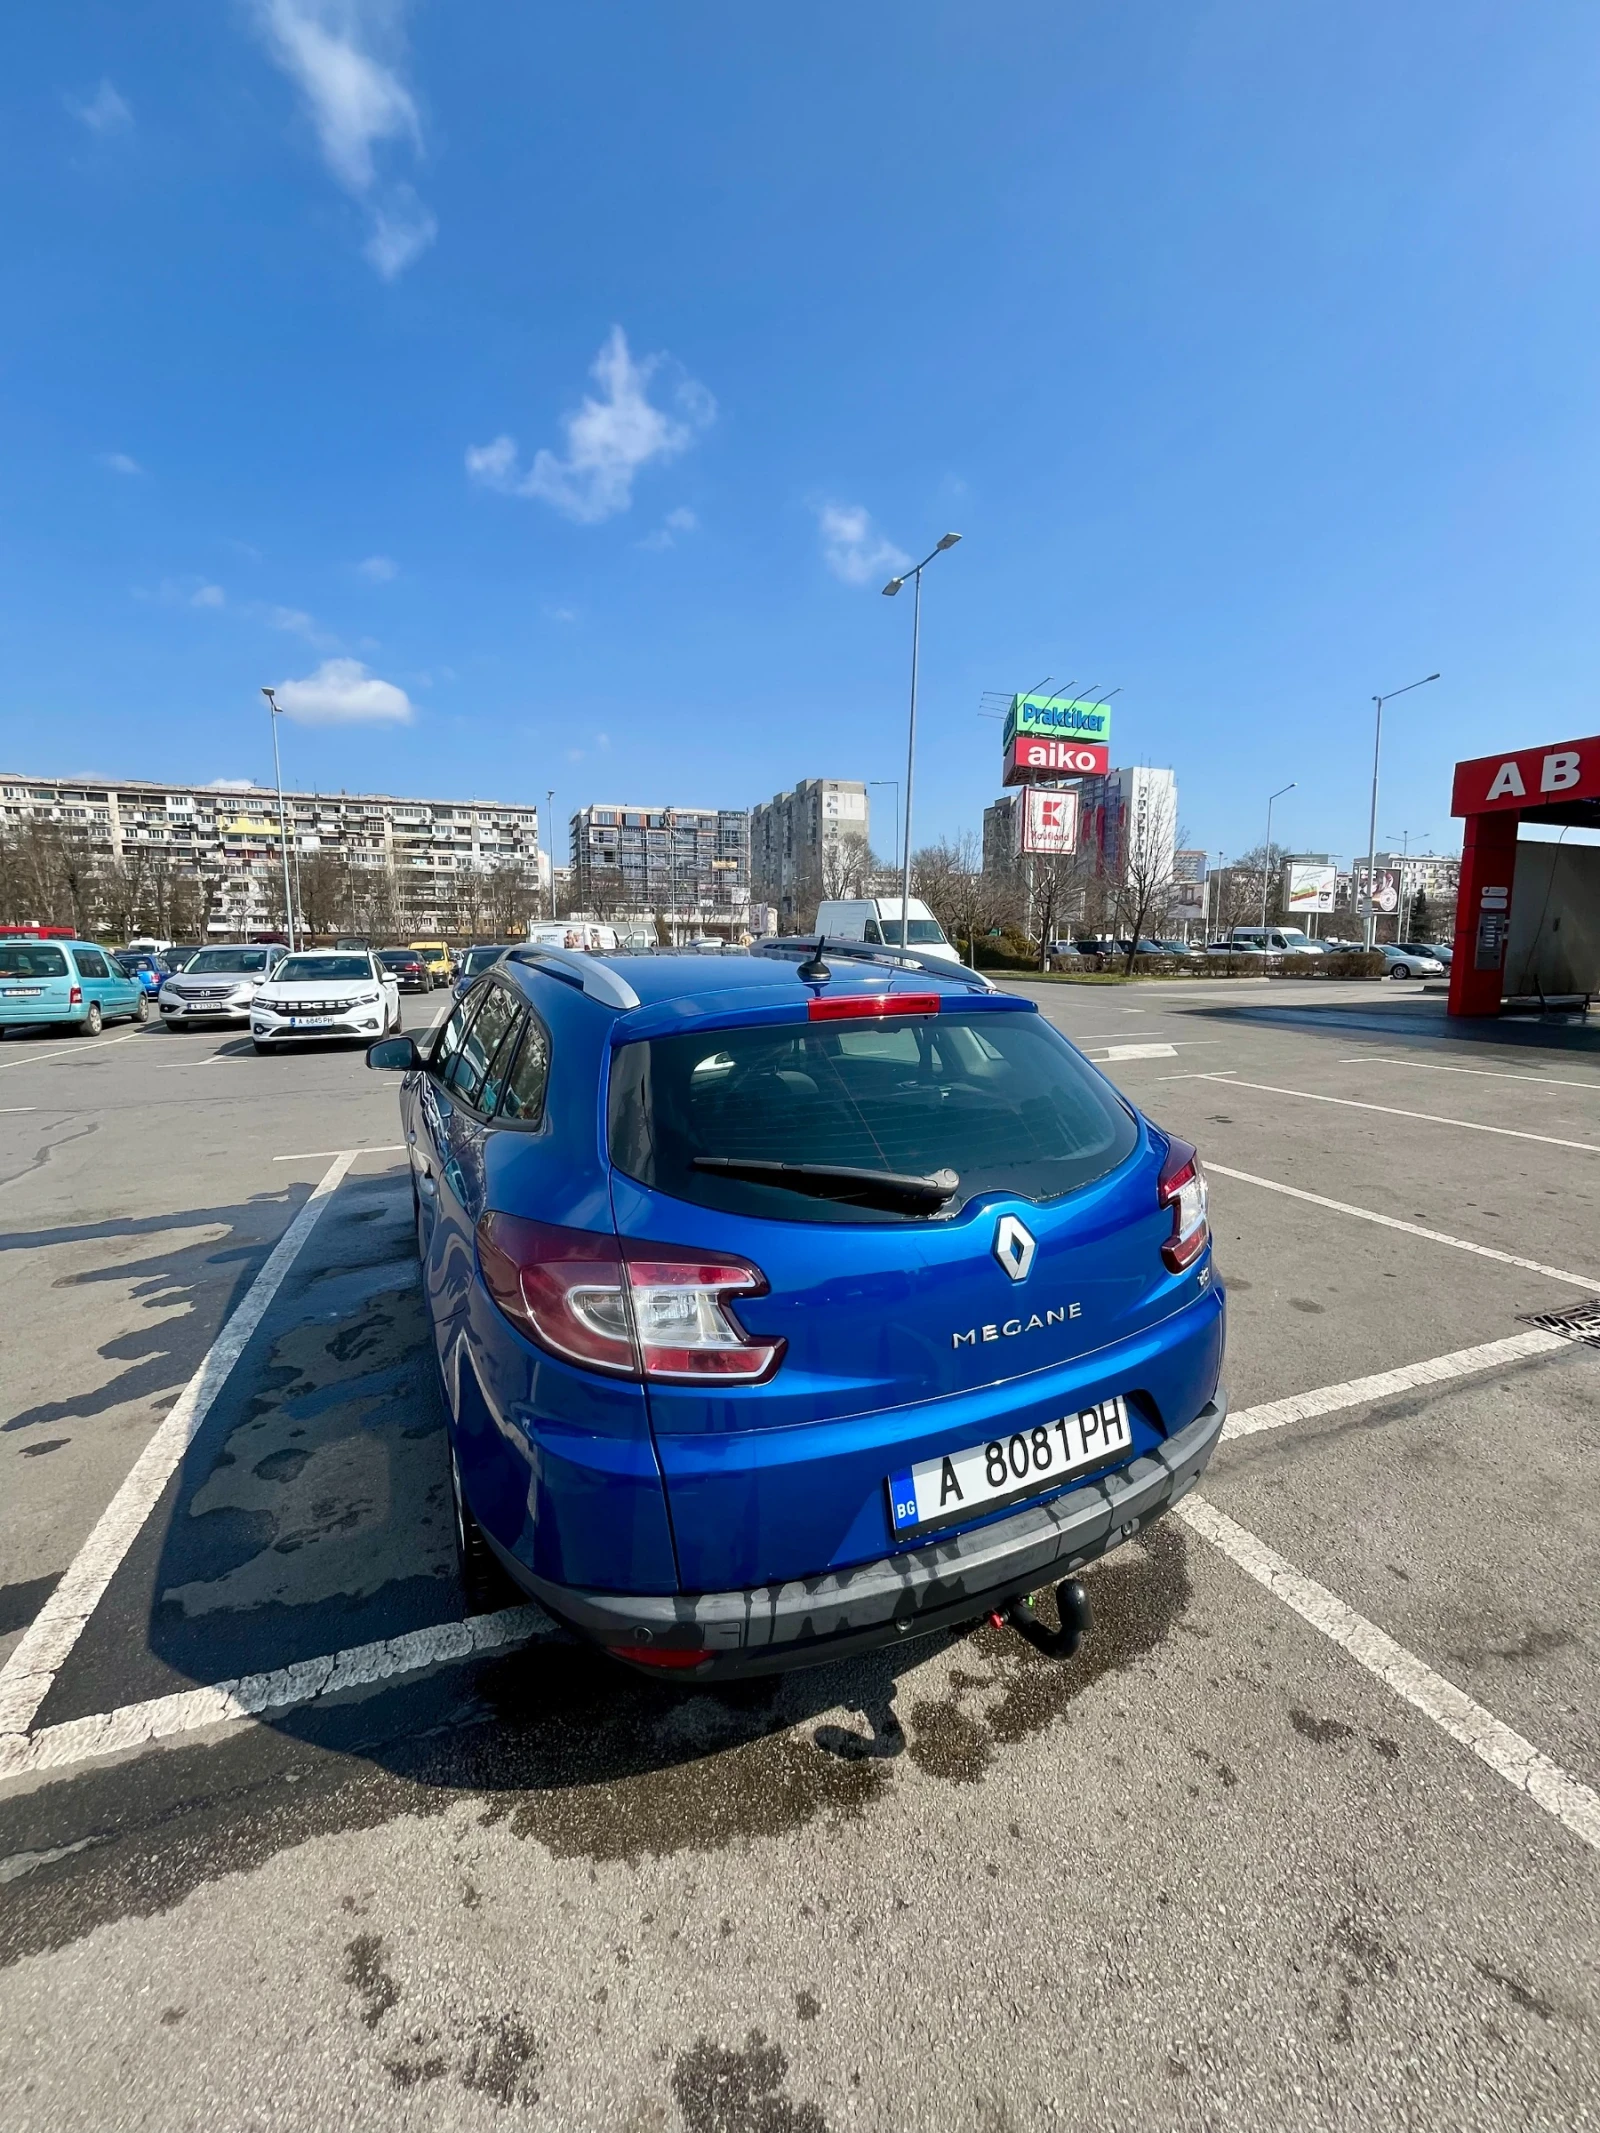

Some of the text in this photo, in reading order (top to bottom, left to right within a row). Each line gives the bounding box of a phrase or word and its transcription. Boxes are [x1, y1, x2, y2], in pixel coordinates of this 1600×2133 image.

[1023, 703, 1105, 731] Praktiker
[1028, 743, 1096, 771] aiko
[952, 1302, 1082, 1349] MEGANE
[940, 1456, 964, 1507] A
[897, 1500, 916, 1519] BG
